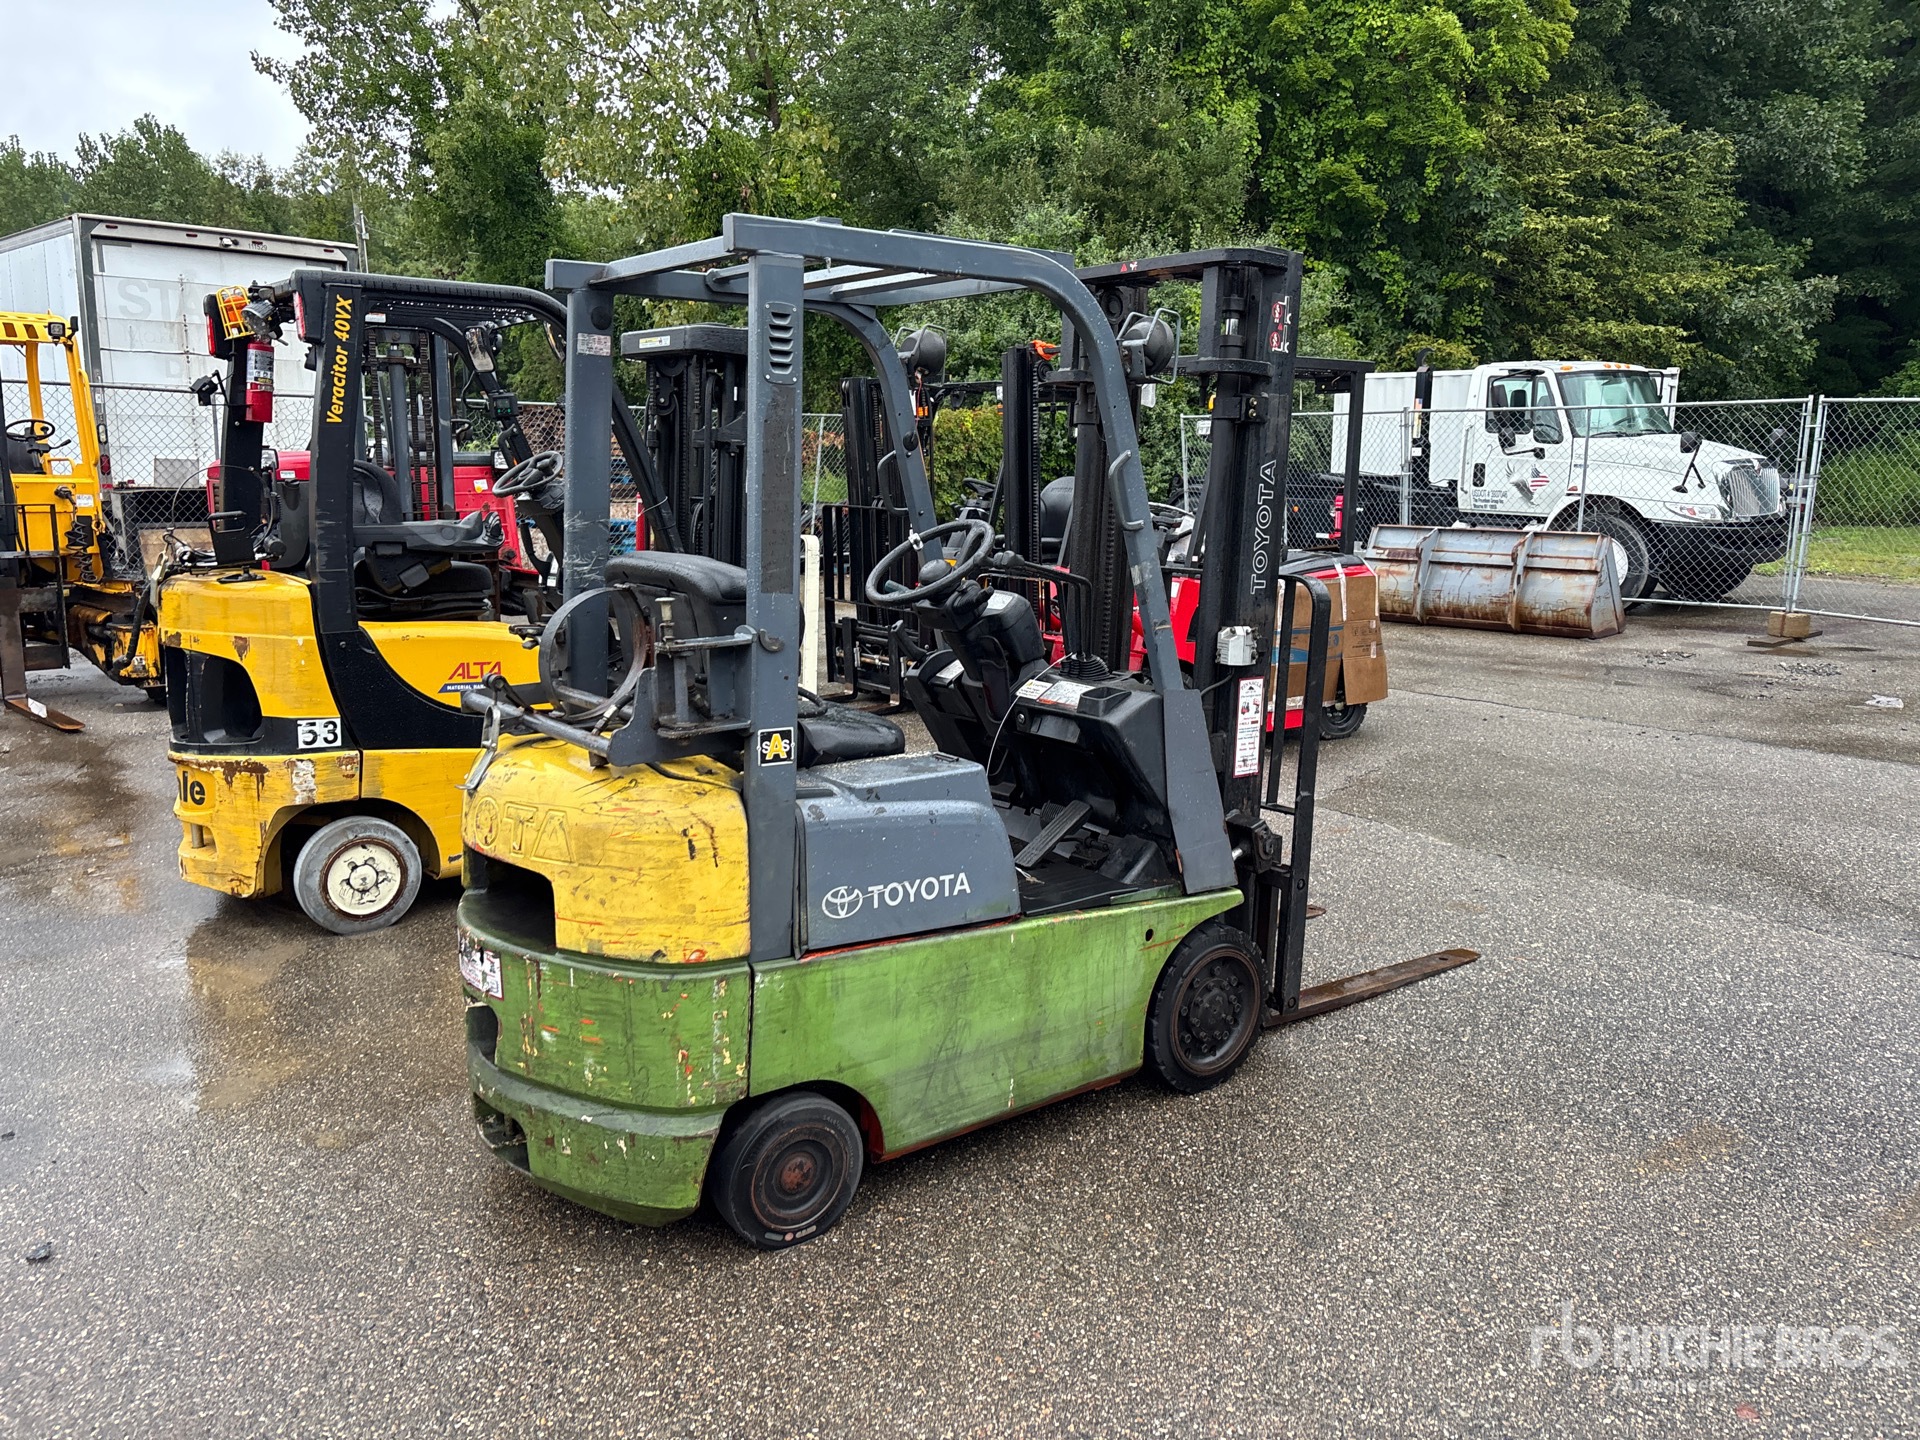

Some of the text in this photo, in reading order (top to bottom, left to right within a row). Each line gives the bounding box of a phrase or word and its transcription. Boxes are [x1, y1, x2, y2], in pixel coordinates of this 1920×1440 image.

[326, 294, 353, 423] Veracitor 40VX
[1250, 459, 1277, 595] TOYOTA
[448, 661, 501, 680] ALTA
[761, 733, 791, 760] SAS
[178, 770, 206, 806] le
[868, 872, 971, 909] TOYOTA
